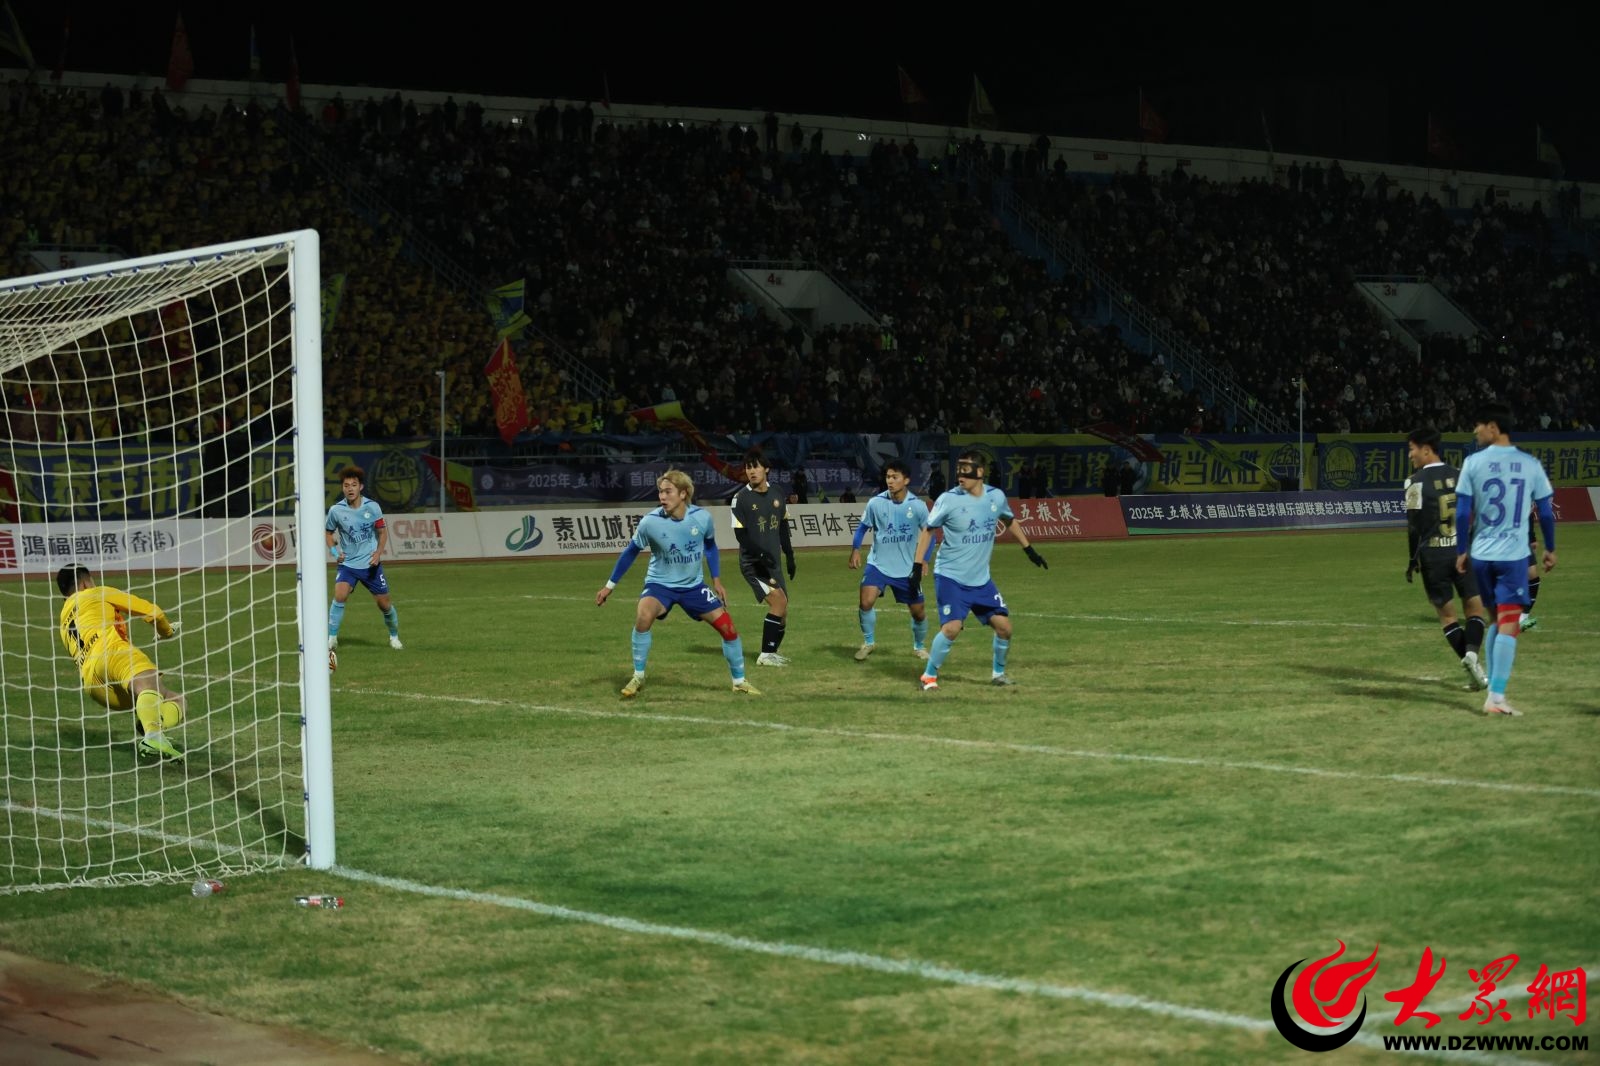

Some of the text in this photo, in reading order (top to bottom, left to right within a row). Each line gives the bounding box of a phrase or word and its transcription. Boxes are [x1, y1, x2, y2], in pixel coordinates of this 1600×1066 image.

[1480, 477, 1525, 529] 31
[1129, 506, 1165, 520] 2025年
[1021, 524, 1082, 537] WULIANGYE
[557, 542, 590, 550] TAISHAN
[591, 541, 617, 549] URBAN
